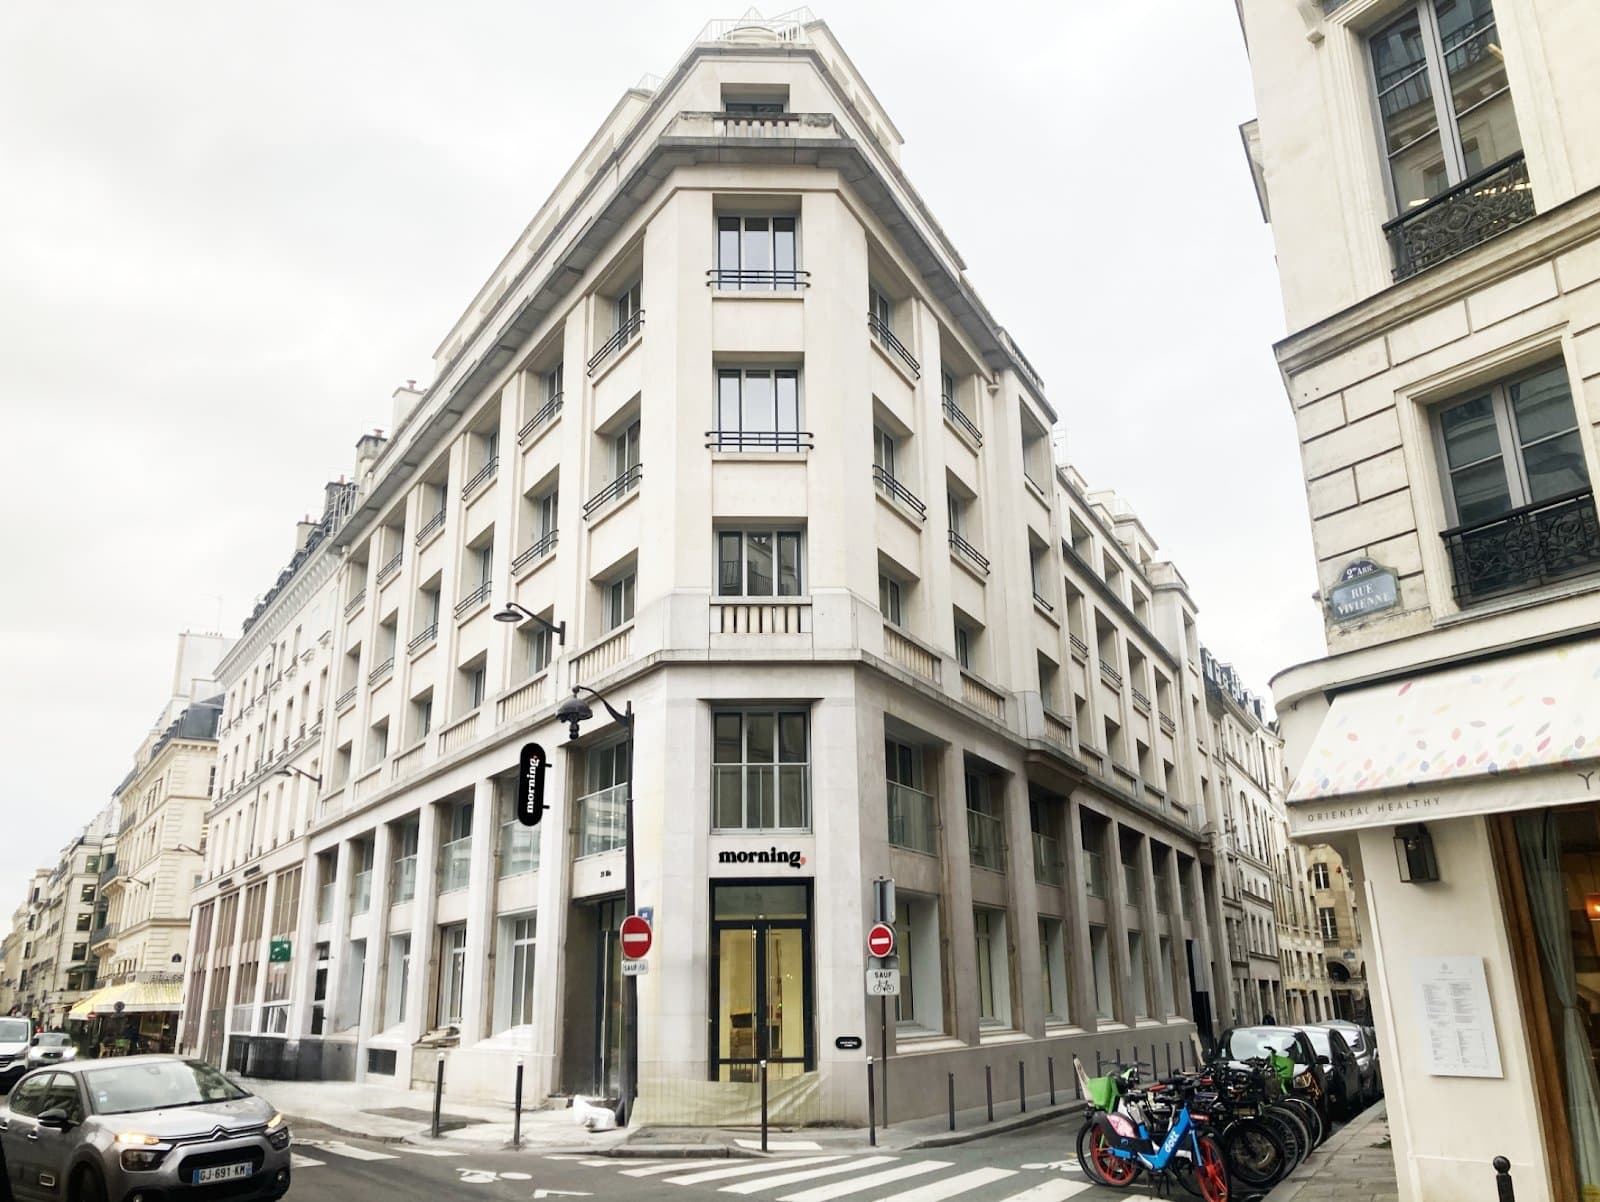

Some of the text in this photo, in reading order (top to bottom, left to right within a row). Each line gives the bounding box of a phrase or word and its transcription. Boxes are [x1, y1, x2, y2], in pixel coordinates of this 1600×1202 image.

[1351, 583, 1374, 599] RUE
[1337, 593, 1391, 615] VIVIENNE
[1307, 796, 1440, 822] ORIENTAL HEALTHY
[874, 971, 893, 979] SAUF
